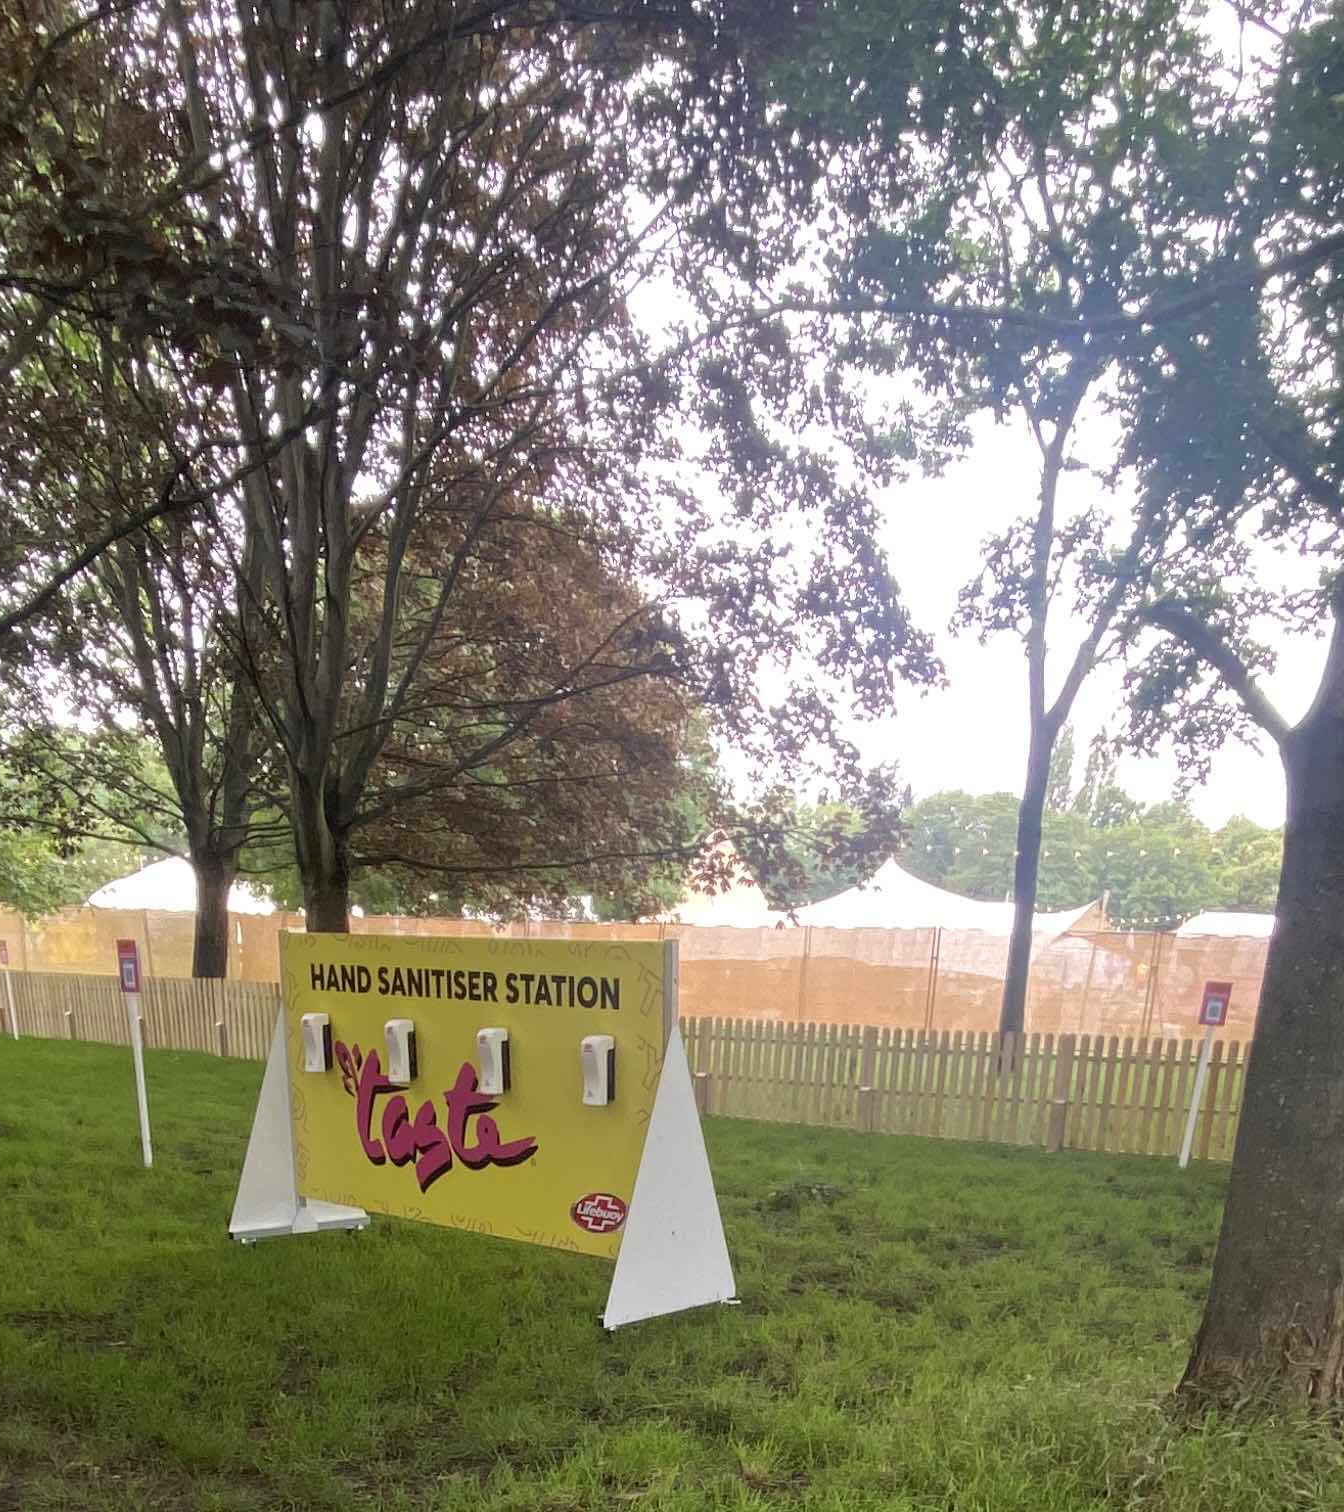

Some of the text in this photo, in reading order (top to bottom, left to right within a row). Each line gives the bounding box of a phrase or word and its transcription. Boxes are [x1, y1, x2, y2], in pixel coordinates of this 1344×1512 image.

[311, 963, 621, 1010] HAND SANITISER STATION
[577, 1203, 625, 1223] Lifebuoy
